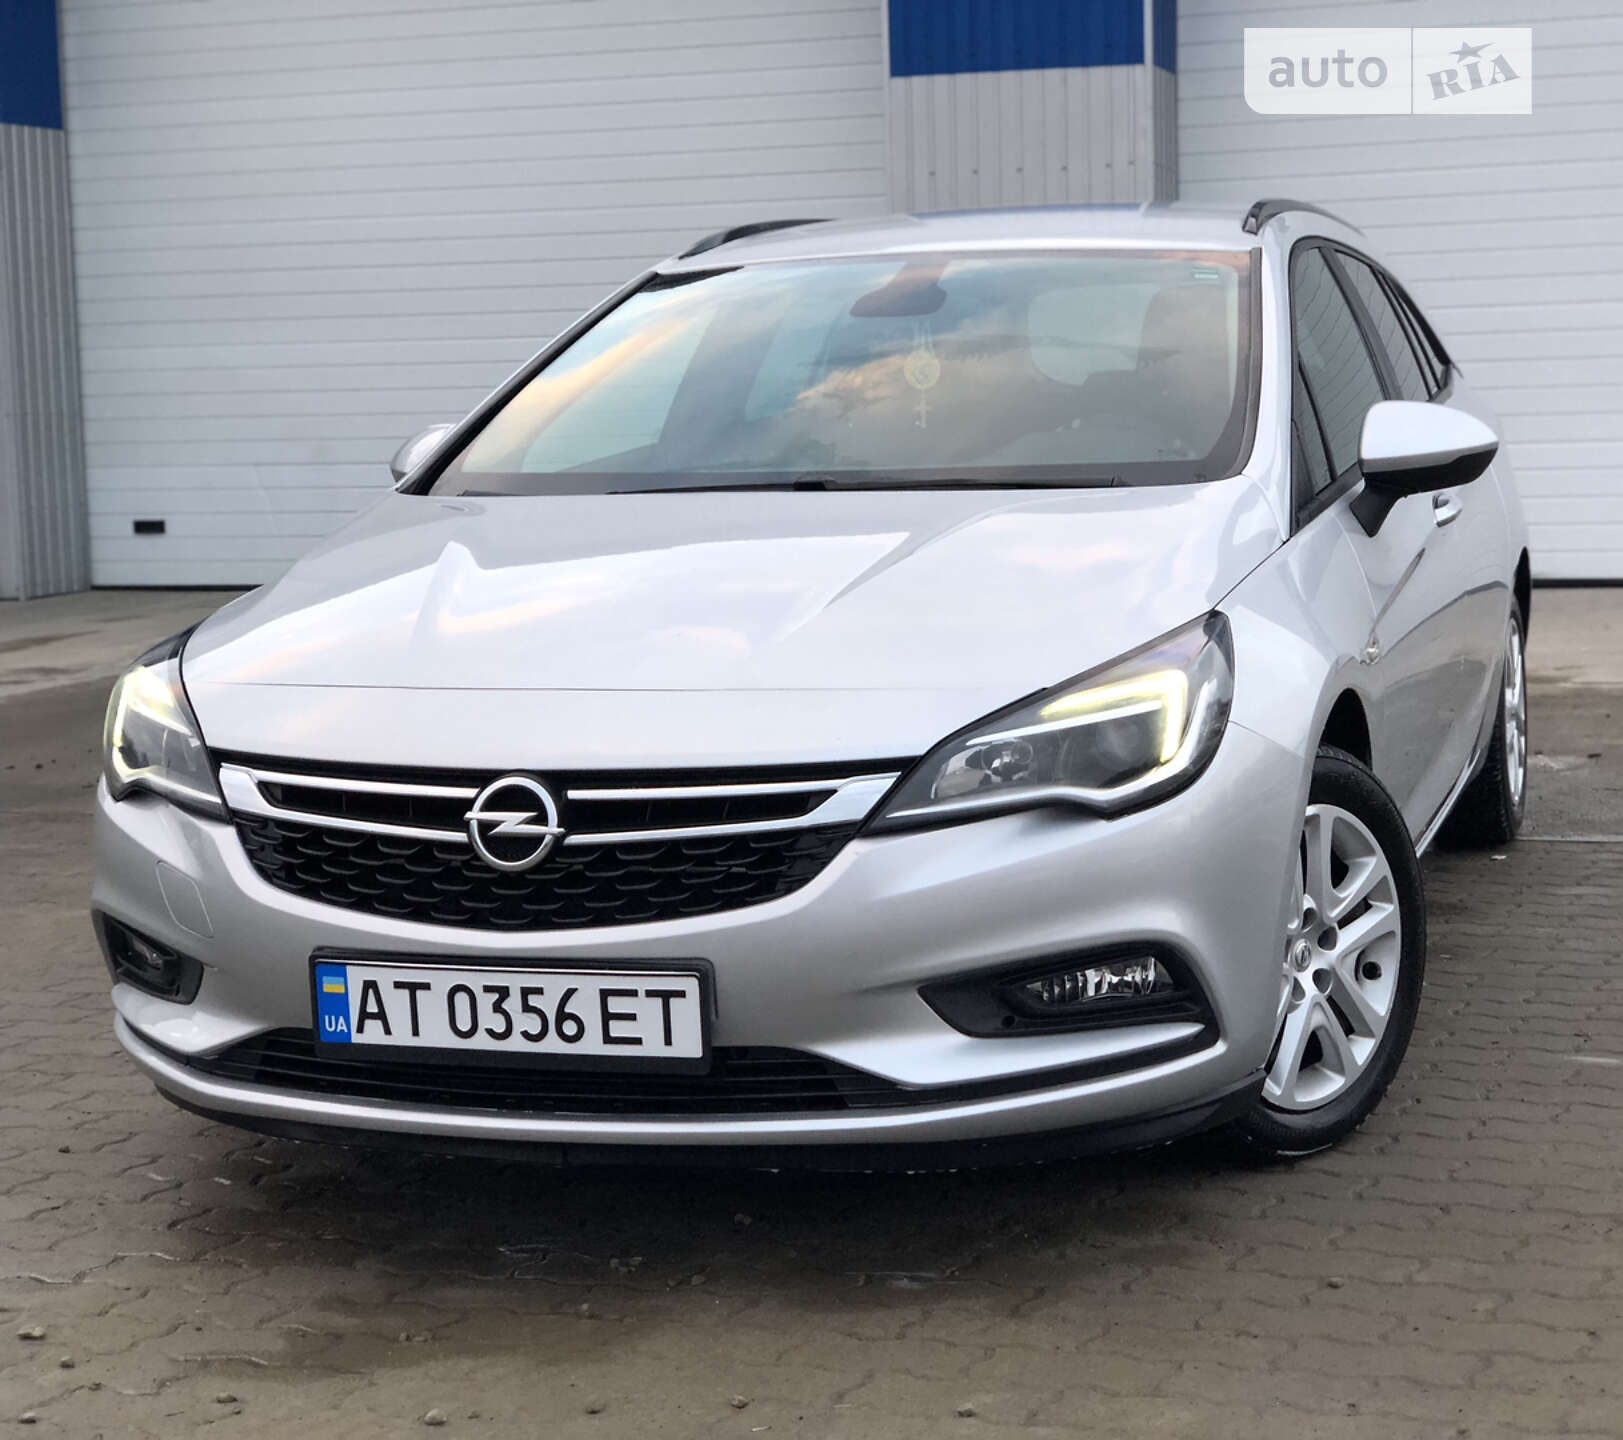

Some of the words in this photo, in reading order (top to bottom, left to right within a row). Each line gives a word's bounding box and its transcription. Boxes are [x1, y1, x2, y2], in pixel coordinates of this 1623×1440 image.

[324, 1015, 348, 1033] UA
[355, 979, 432, 1037] AT
[446, 983, 585, 1044] 0356
[599, 987, 687, 1047] ET
